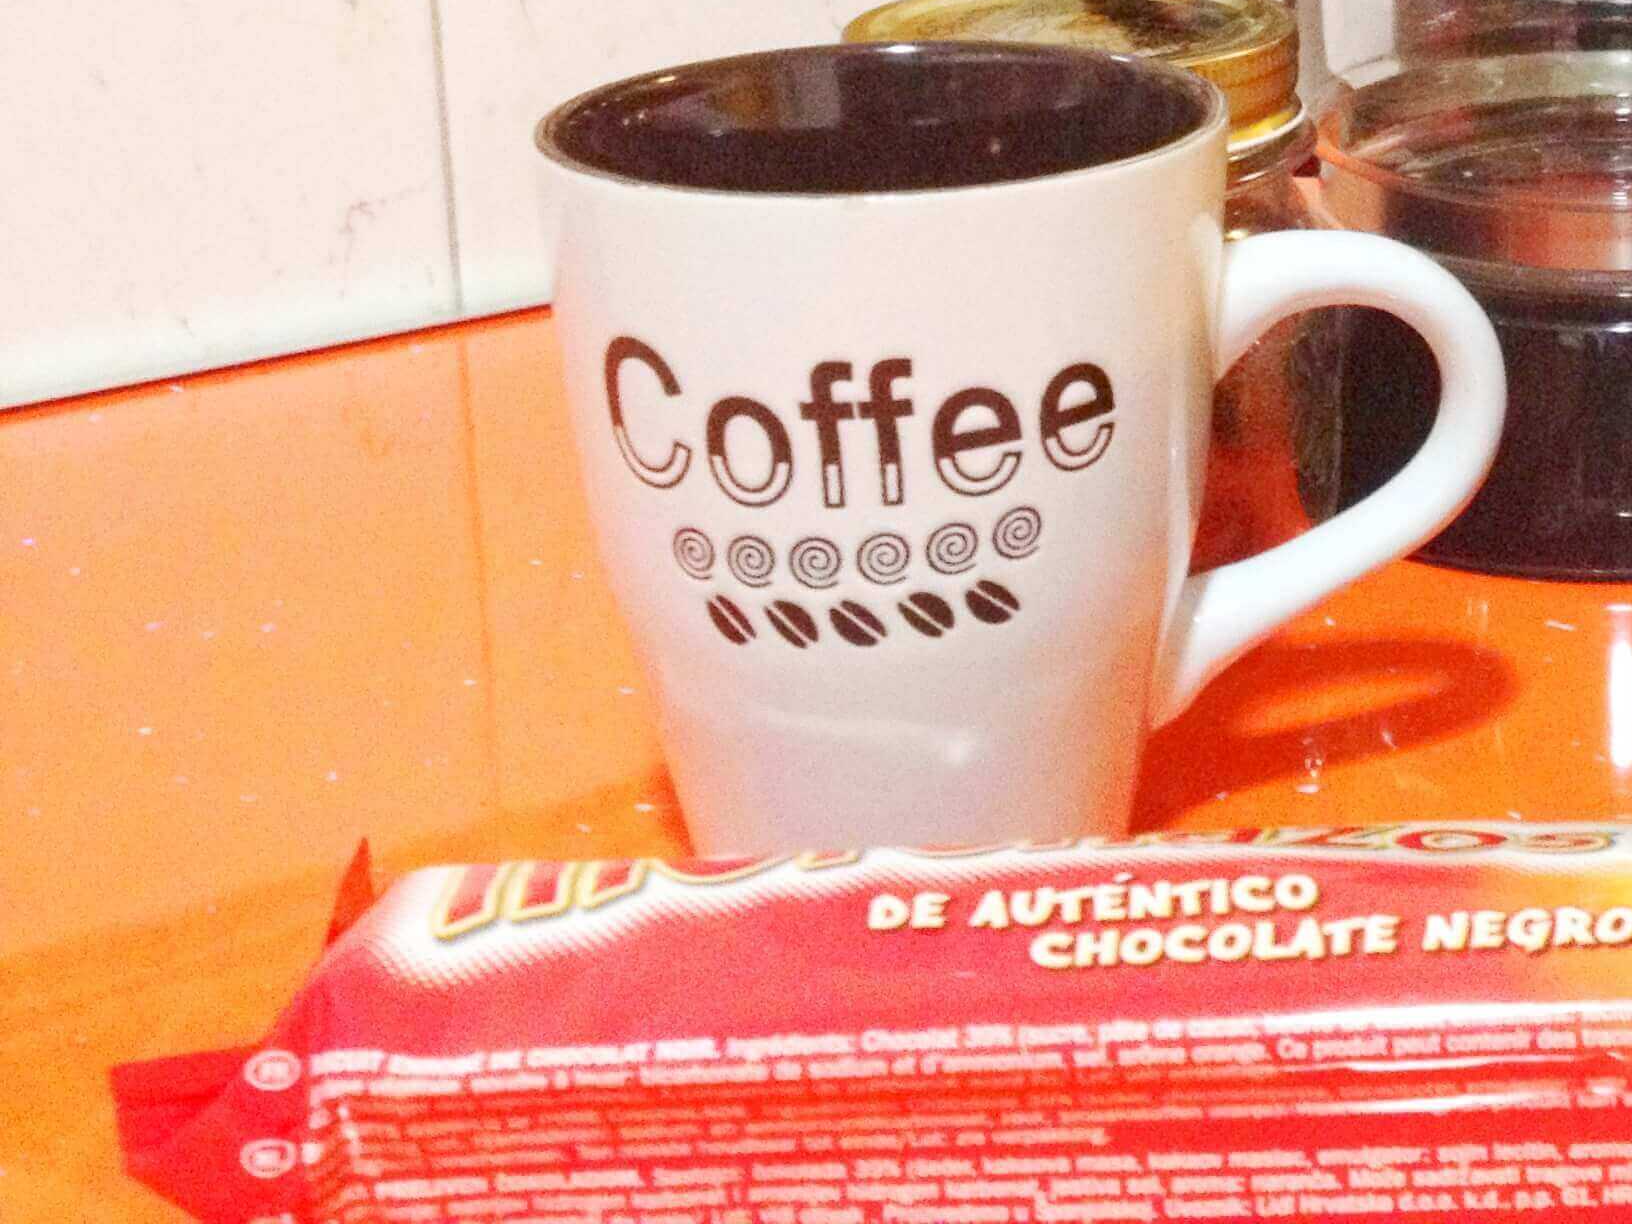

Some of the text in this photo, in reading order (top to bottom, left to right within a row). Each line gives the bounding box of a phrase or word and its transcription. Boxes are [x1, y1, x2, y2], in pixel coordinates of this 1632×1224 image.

[603, 335, 1116, 509] Coffee
[867, 891, 951, 930] DE
[968, 871, 1319, 929] AUTÉNTICO
[1028, 914, 1398, 968] CHOCOLATE
